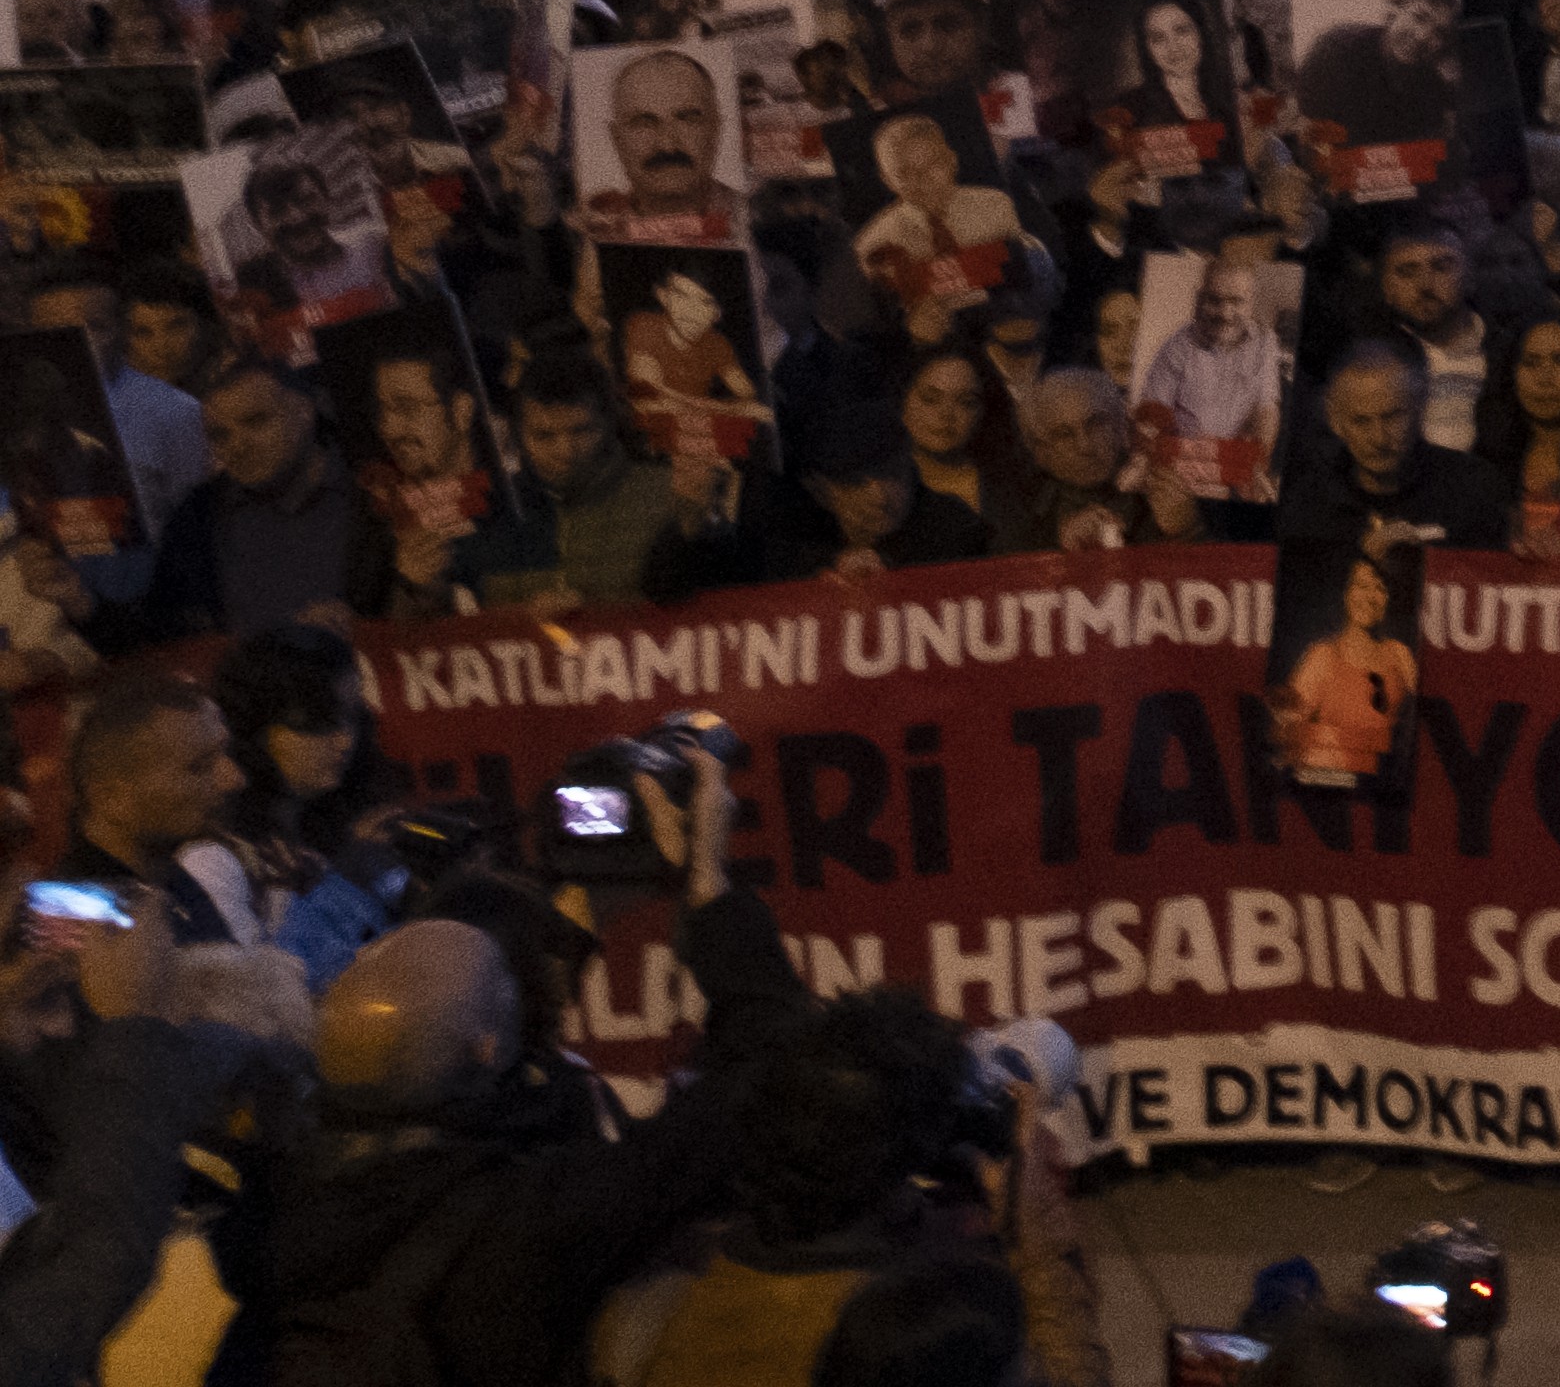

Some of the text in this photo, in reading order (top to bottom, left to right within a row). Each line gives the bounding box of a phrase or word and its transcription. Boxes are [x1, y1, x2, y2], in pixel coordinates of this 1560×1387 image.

[842, 578, 1275, 682] UNUTMADI
[928, 887, 1439, 1023] HESABINI
[1075, 1069, 1172, 1141] VE
